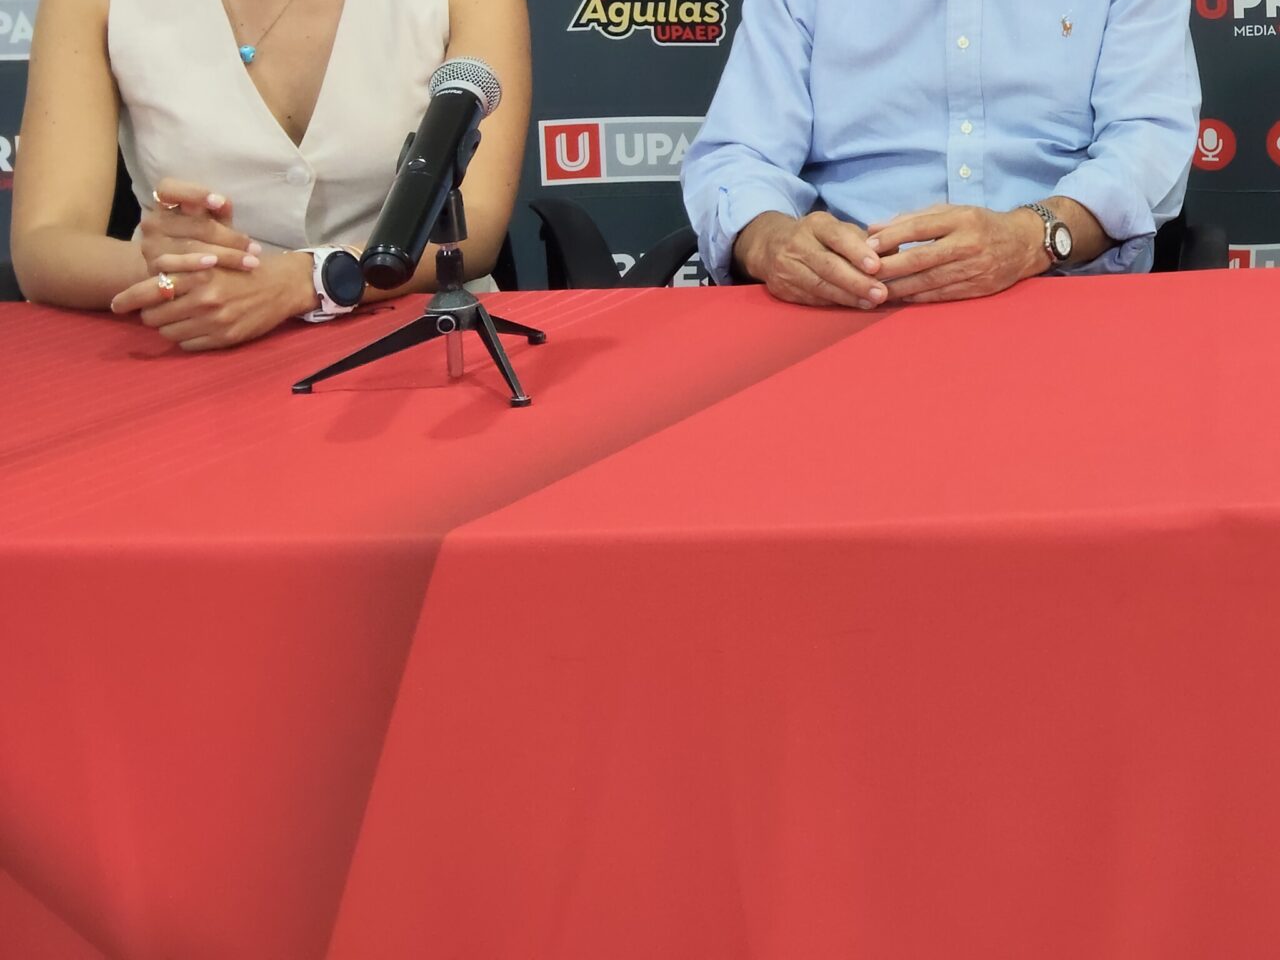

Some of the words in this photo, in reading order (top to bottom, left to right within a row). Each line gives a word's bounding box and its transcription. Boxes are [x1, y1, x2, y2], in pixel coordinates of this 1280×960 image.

[656, 23, 720, 41] UPAEP
[1235, 25, 1276, 36] MEDIA
[556, 132, 589, 171] U
[616, 133, 690, 166] UPA
